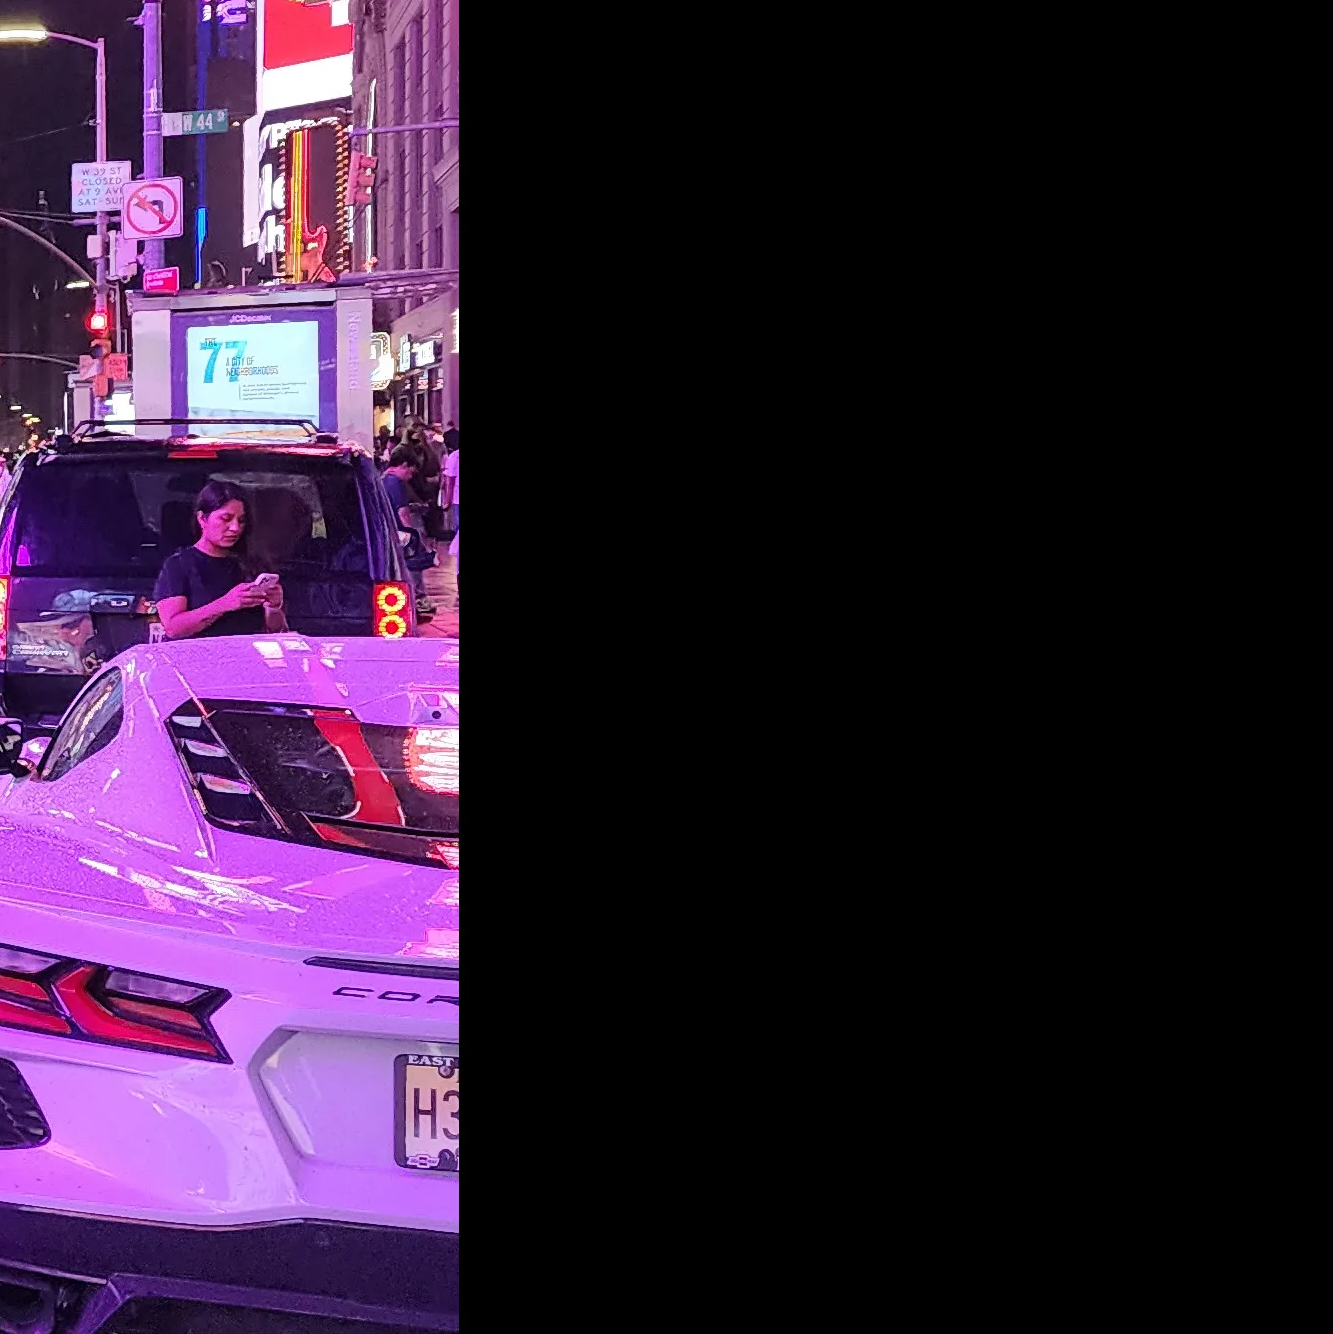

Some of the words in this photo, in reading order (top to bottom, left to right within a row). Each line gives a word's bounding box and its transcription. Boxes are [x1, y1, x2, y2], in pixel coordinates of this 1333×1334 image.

[196, 112, 214, 130] 44
[110, 166, 122, 175] ST
[81, 177, 123, 187] CLOSED
[77, 188, 91, 197] AT
[199, 340, 248, 384] 77
[407, 1054, 455, 1067] EAST
